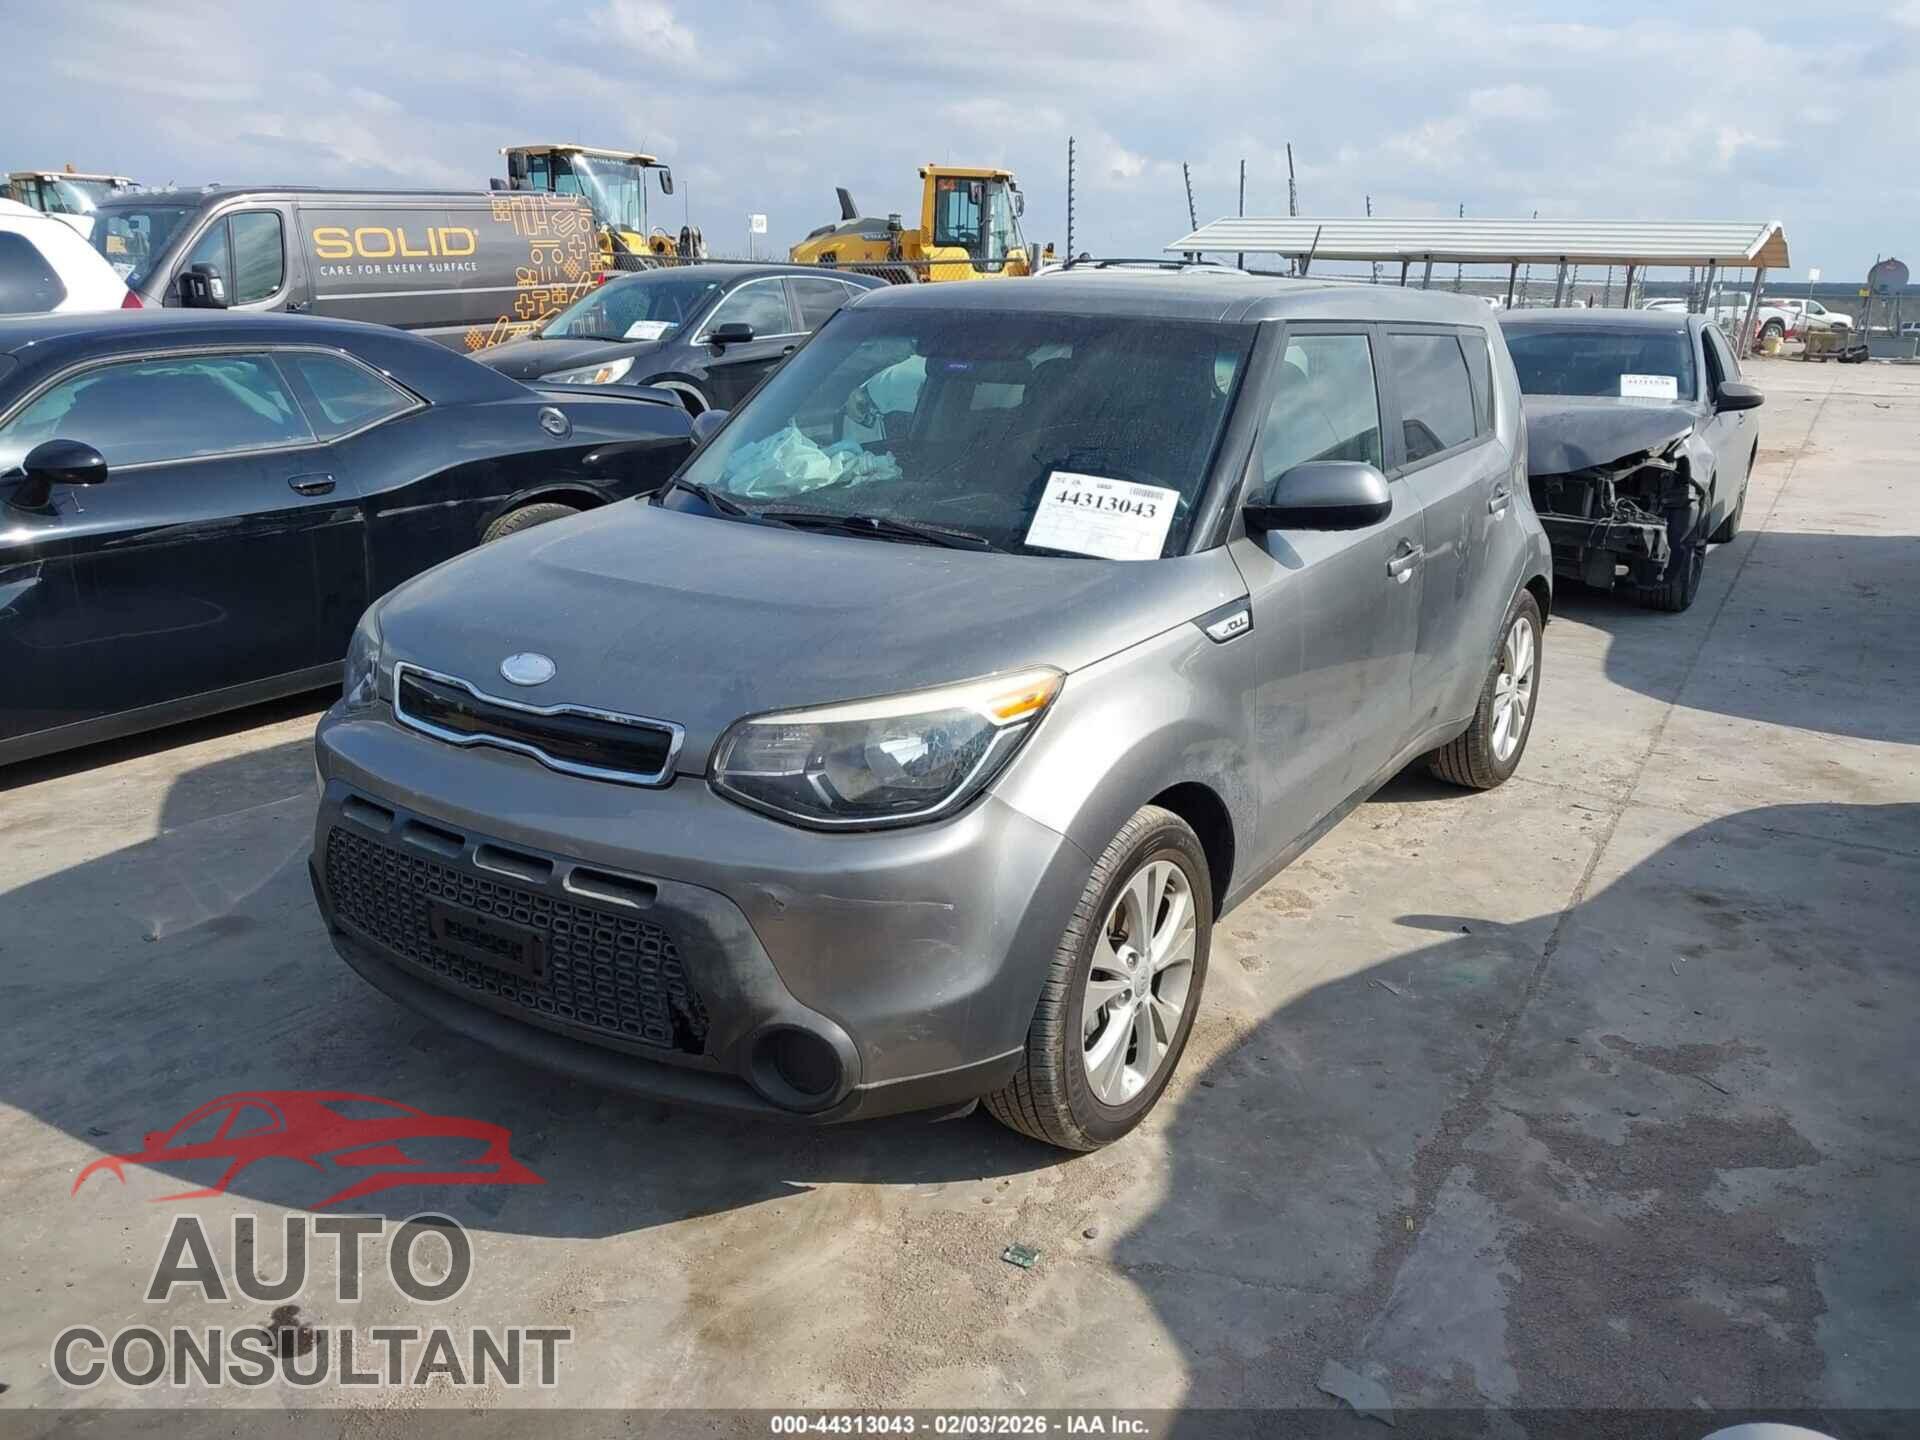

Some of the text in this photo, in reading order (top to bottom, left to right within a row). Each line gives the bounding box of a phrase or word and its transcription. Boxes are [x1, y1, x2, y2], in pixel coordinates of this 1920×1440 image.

[312, 226, 477, 258] SOLID
[320, 261, 478, 276] CARE FOR EVERY SURFACE
[1056, 489, 1157, 519] 44313043
